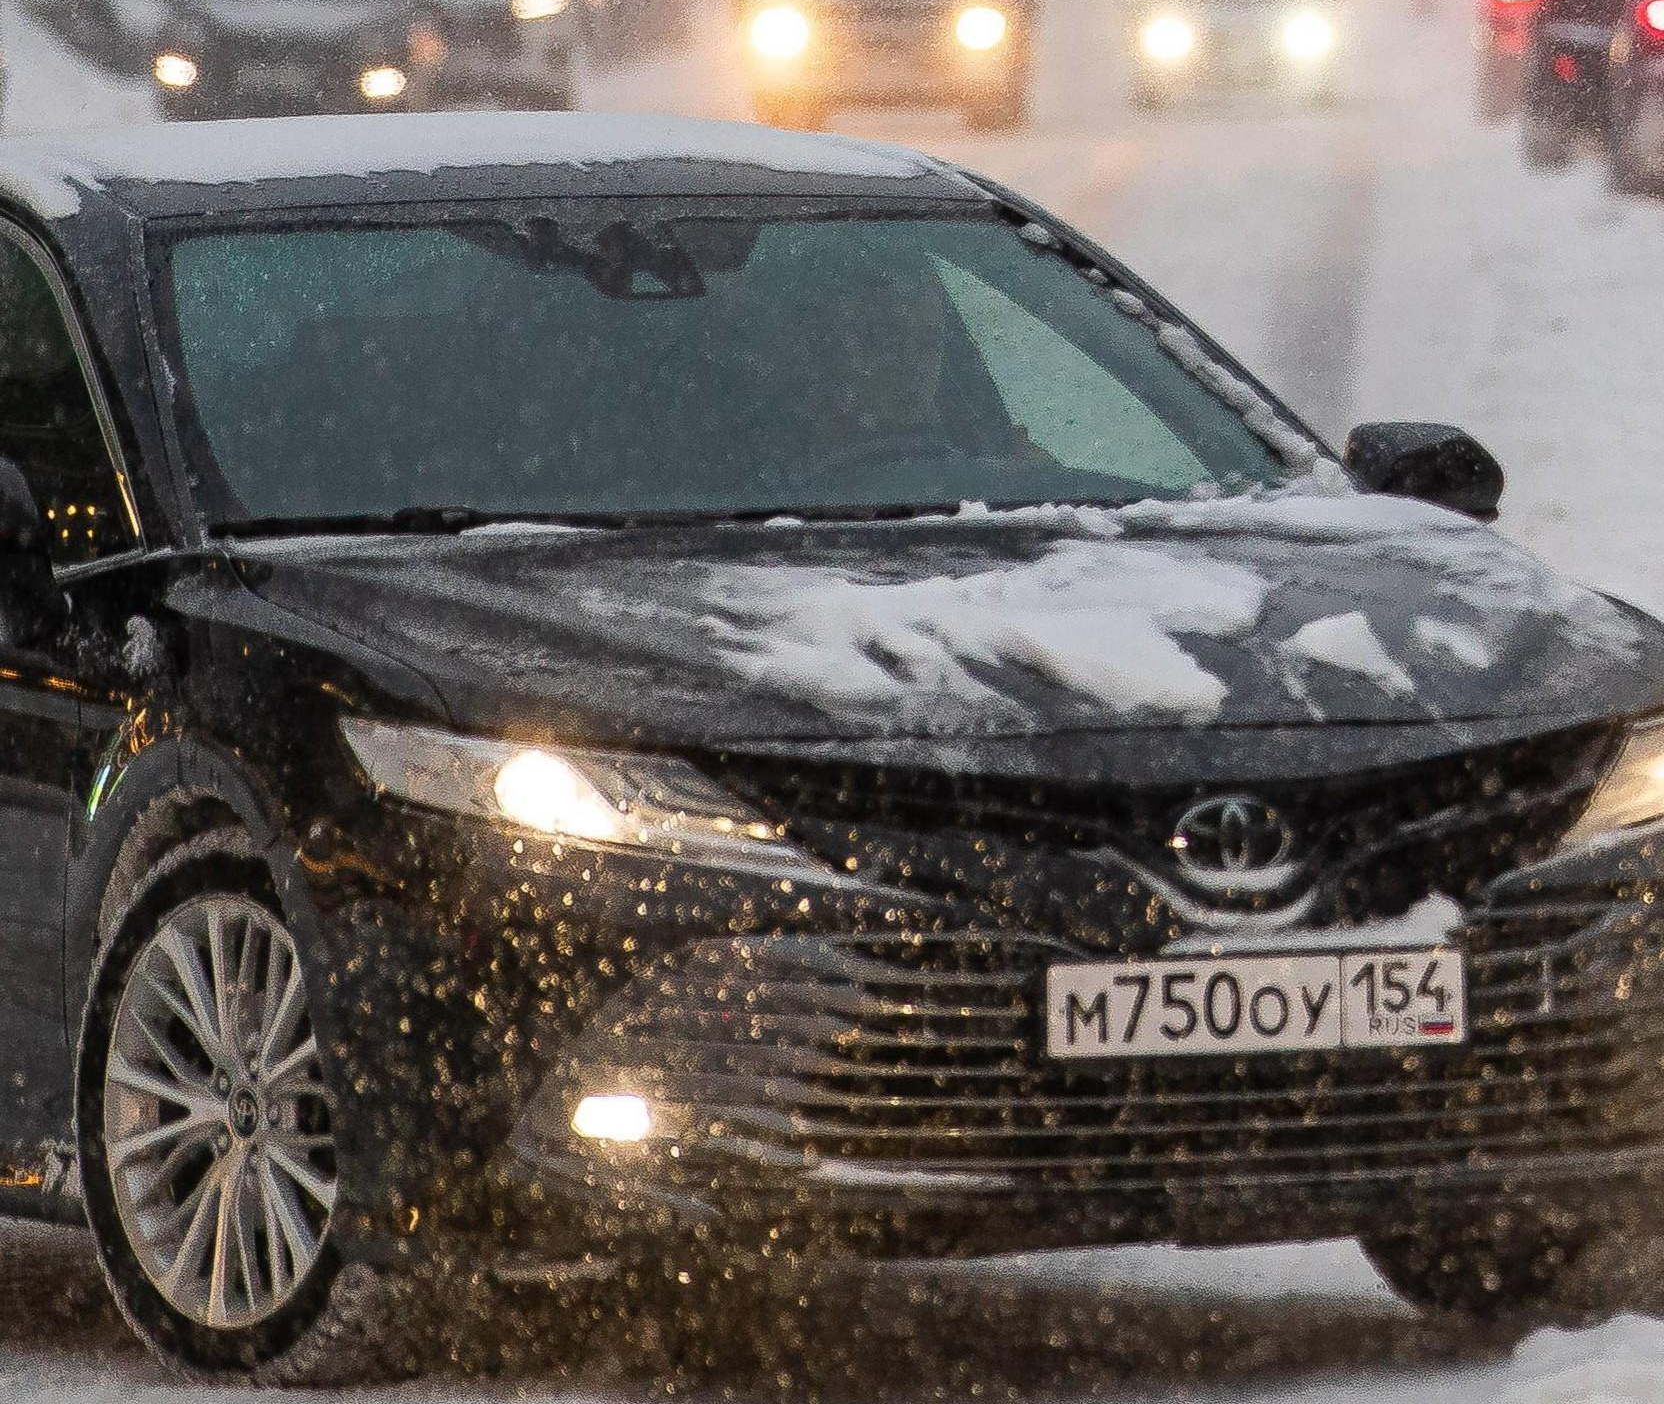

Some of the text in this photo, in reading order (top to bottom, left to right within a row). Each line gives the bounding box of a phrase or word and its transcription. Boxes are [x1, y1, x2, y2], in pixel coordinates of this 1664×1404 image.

[1064, 960, 1450, 1045] М750ОУ 154
[1369, 1015, 1416, 1037] RUS
